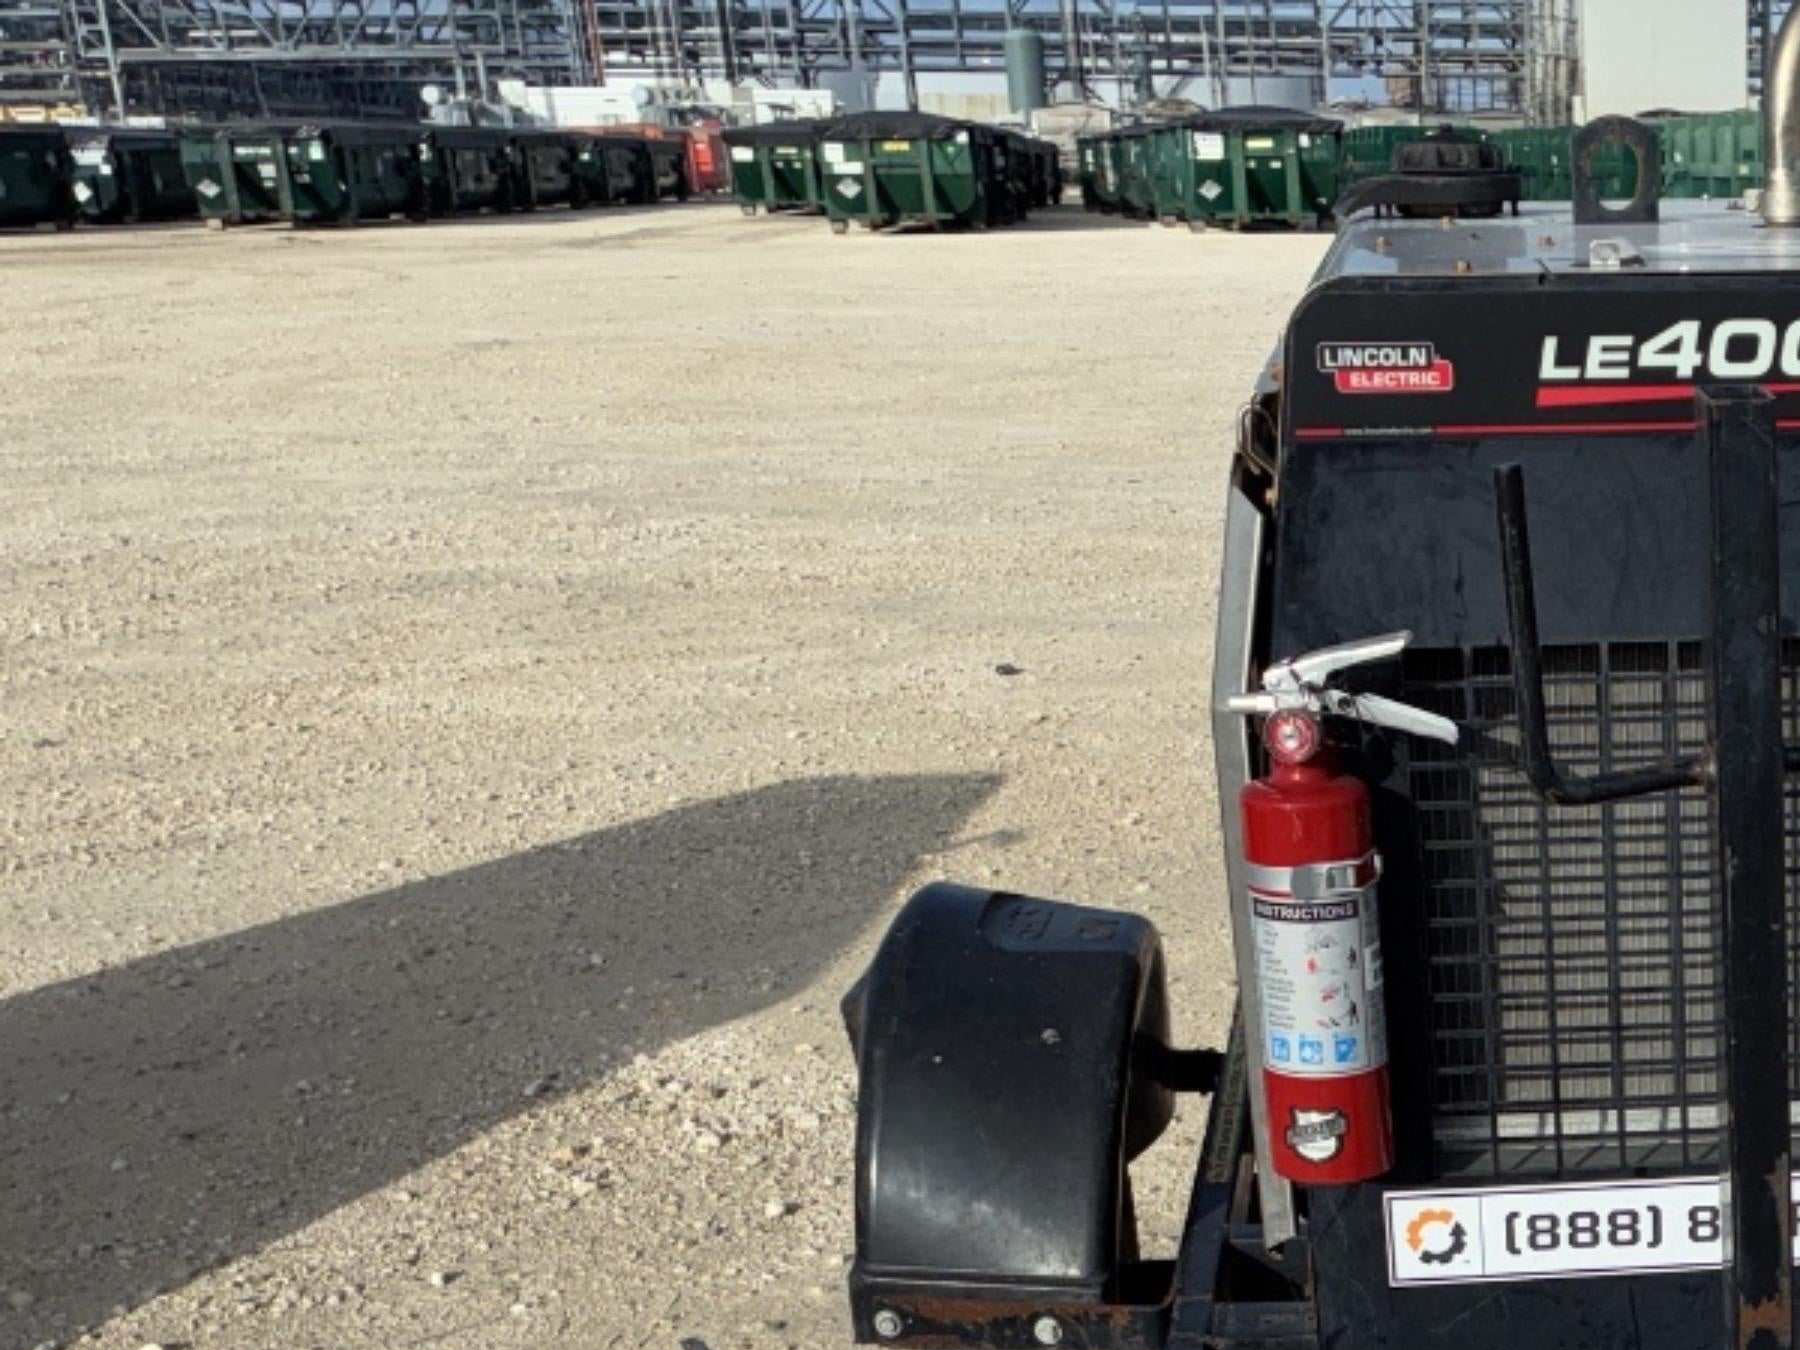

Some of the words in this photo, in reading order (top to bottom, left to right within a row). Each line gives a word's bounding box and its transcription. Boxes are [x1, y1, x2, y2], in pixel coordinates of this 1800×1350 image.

[1324, 347, 1426, 368] LINCOLN
[1349, 371, 1441, 387] ELECTRIC
[1505, 1205, 1663, 1255] (888)
